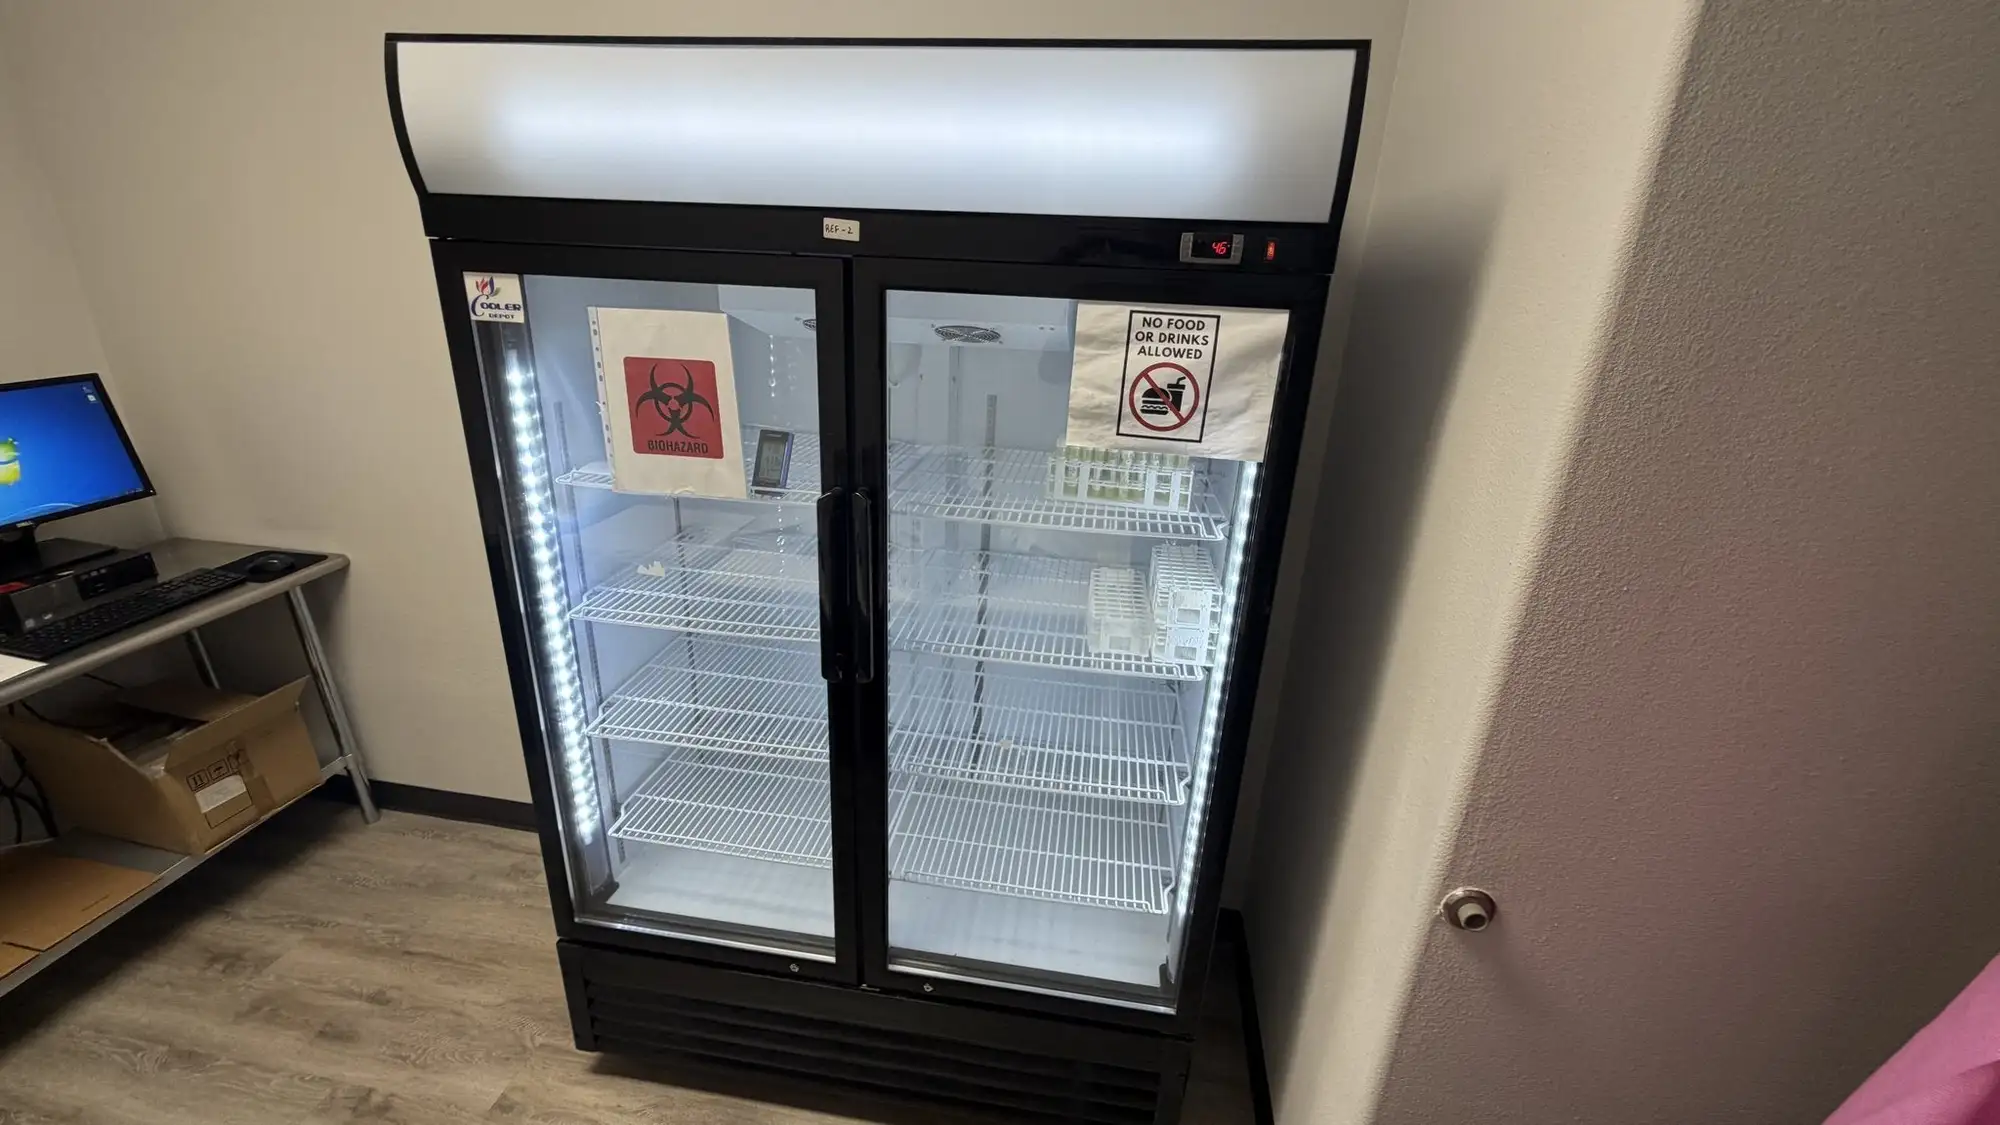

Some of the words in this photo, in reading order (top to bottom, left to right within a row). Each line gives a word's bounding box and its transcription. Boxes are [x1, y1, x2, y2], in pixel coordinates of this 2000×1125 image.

[471, 294, 521, 317] COOLER
[1142, 317, 1163, 328] NO
[1167, 318, 1205, 331] FOOD
[1135, 331, 1154, 342] OR
[1158, 332, 1209, 346] DRINKS
[1137, 345, 1203, 360] ALLOWED
[647, 440, 709, 454] BIOHAZARD
